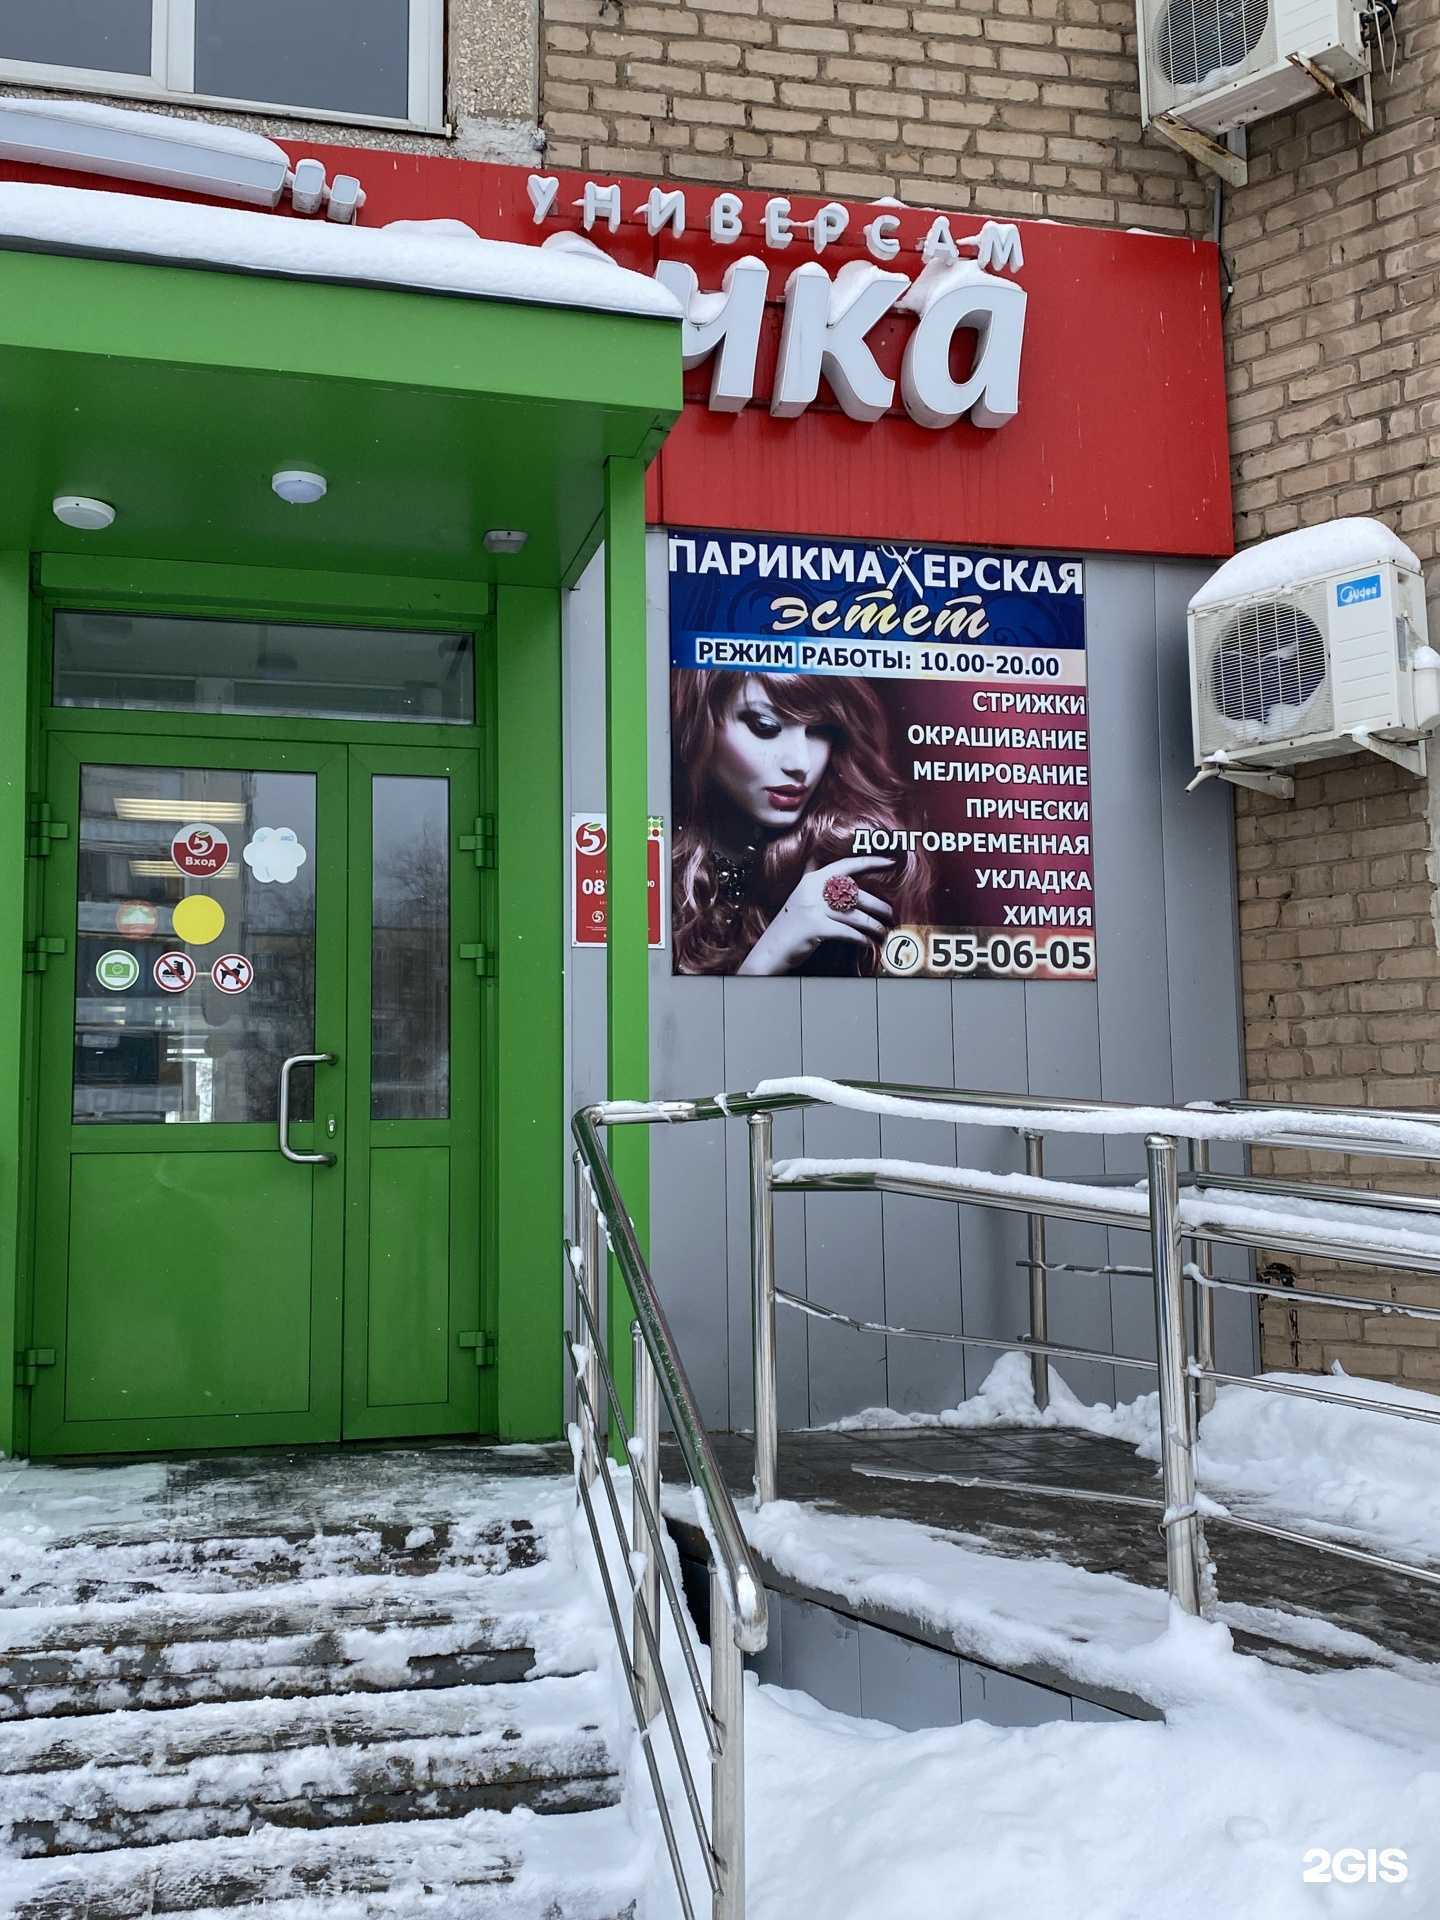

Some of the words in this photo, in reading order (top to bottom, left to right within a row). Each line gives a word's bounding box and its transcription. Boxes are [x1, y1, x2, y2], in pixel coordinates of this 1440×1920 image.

[527, 173, 1024, 273] УНИВЕРСАМ
[654, 256, 1028, 429] чка
[669, 538, 1084, 598] ПАРИКМАХЕРСКАЯ
[698, 641, 793, 665] РЕЖИМ
[802, 646, 911, 671] РАБОТЫ:
[920, 651, 1060, 677] 10.00-20.00
[971, 690, 1087, 715] СТРИЖКИ
[907, 724, 1088, 751] ОКРАШИВАНИЕ
[912, 760, 1089, 786] МЕЛИРОВАНИЕ
[965, 797, 1090, 821] ПРИЧЕСКИ
[851, 828, 1090, 855] ДОЛГОВРЕМЕННАЯ
[185, 856, 217, 867] Вход
[582, 878, 607, 895] 08
[974, 868, 1093, 893] УКЛАДКА
[1002, 904, 1093, 927] ХИМИЯ
[931, 938, 1092, 970] 55-06-05
